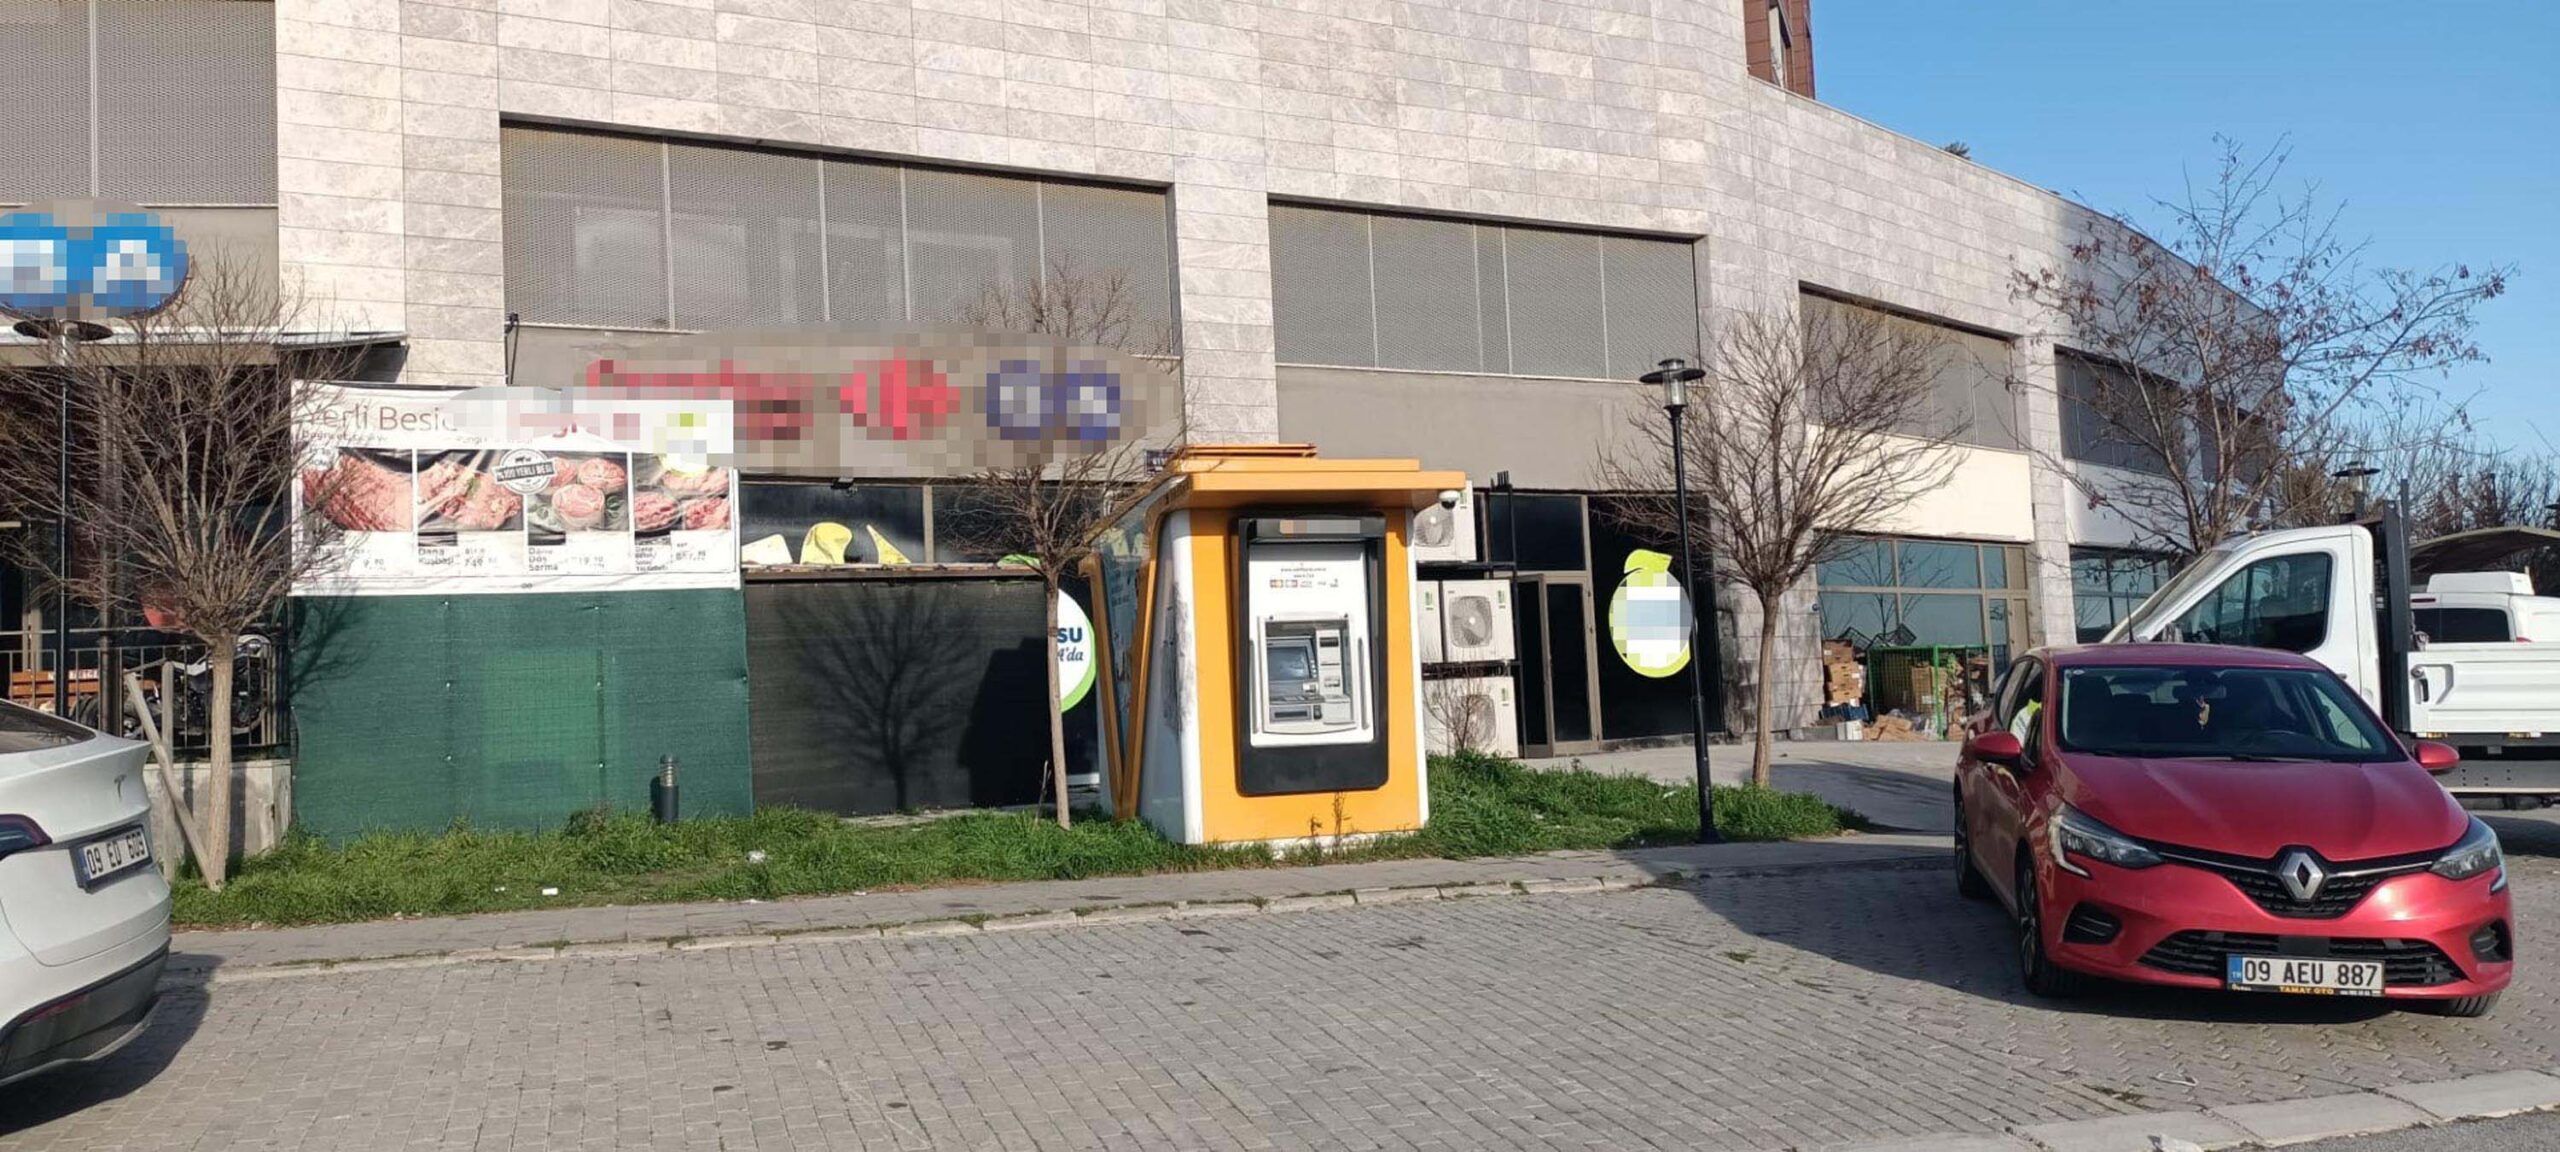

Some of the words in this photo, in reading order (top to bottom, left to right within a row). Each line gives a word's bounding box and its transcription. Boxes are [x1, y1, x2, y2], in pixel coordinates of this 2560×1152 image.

[86, 846, 104, 874] 09
[2244, 960, 2271, 982] 09
[2282, 961, 2324, 985] AEU
[2337, 963, 2378, 987] 887
